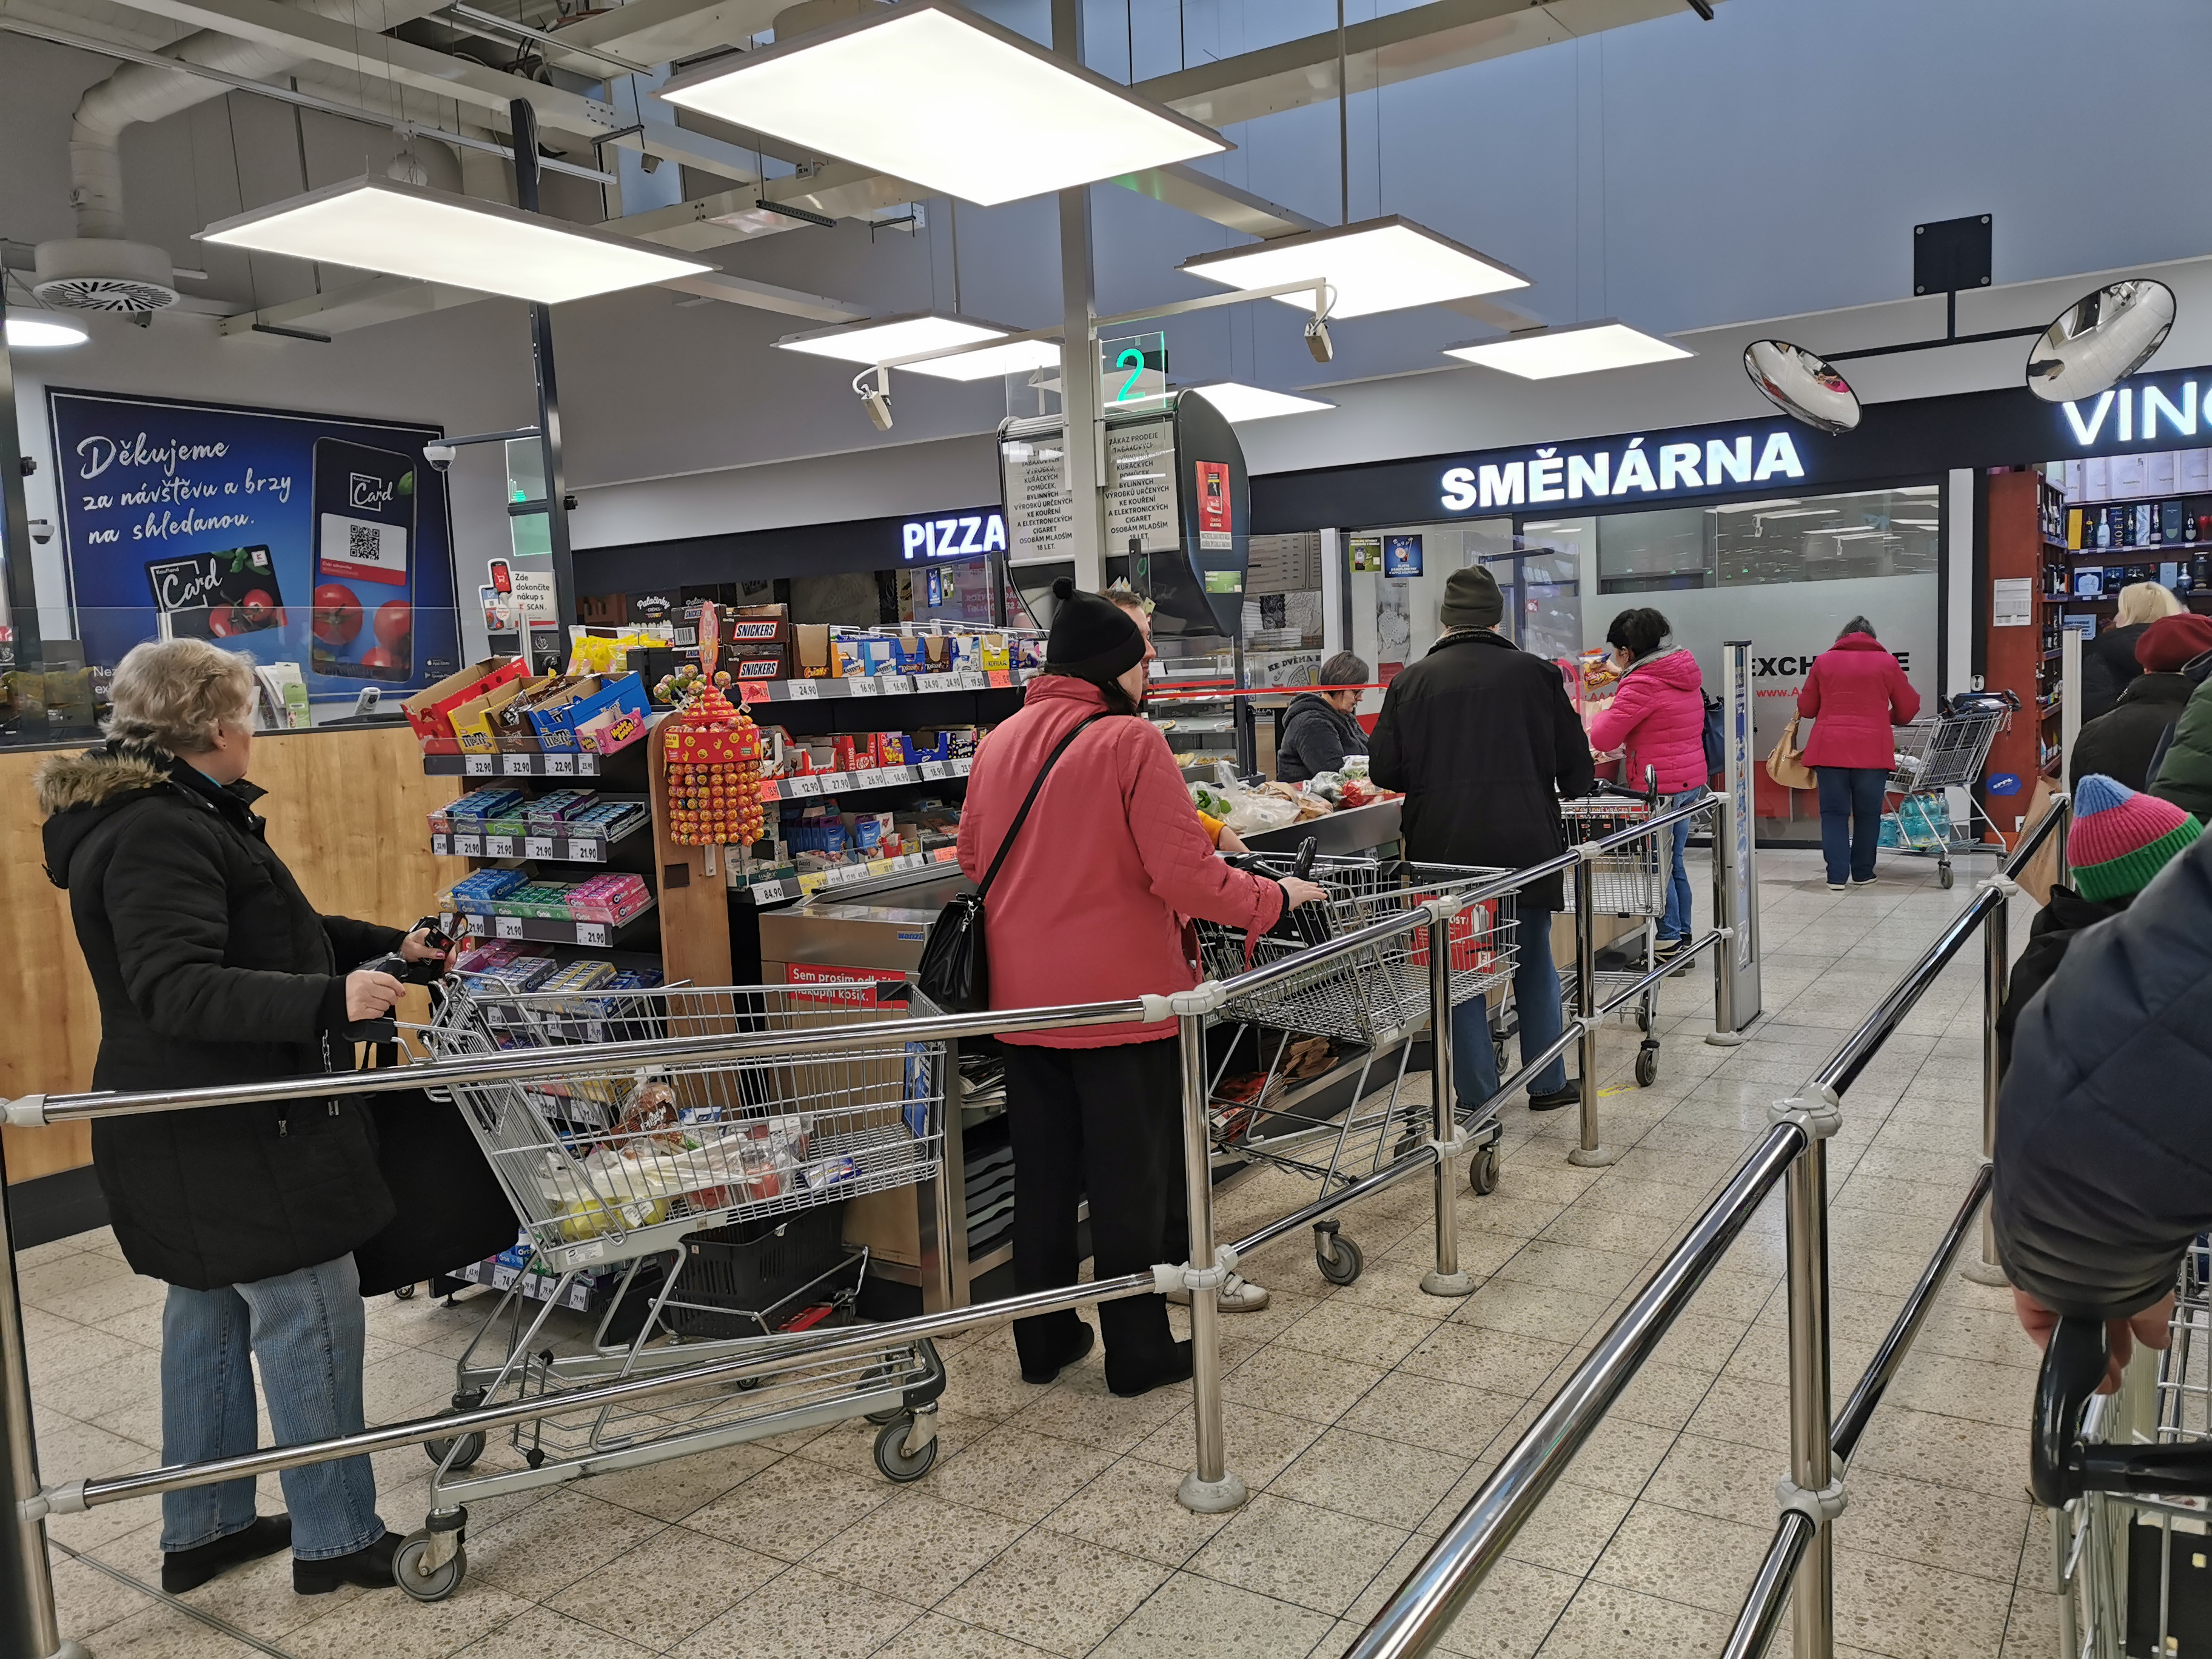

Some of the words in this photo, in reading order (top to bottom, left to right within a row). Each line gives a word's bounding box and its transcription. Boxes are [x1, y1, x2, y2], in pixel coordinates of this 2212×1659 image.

[1116, 349, 1145, 401] 2
[2063, 382, 2212, 445] VIN
[1109, 436, 1130, 446] ZÁKAZ
[1131, 432, 1158, 441] PRODEJE
[77, 432, 229, 479] Děkujeme
[1441, 432, 1805, 511] SMĚNÁRNA
[1024, 474, 1058, 483] KUŘÁCKÝCH
[83, 495, 113, 511] za
[121, 479, 218, 505] návštěvu
[224, 482, 239, 494] a
[245, 468, 291, 503] brzy
[354, 481, 394, 505] Card
[1105, 489, 1134, 499] VÝROBKŮ
[1136, 485, 1169, 495] URČENÝCH
[1027, 491, 1059, 500] BYLINNÝCH
[1128, 495, 1156, 505] KOUŘENÍ
[1014, 501, 1041, 511] VÝROBKŮ
[1042, 497, 1073, 507] URČENÝCH
[1114, 503, 1168, 515] ELEKTRONICKÝCH
[1036, 507, 1061, 516] KOUŘENÍ
[1023, 515, 1072, 526] ELEKTRONICKÝCH
[1125, 515, 1151, 523] CIGARET
[89, 529, 119, 545] na
[132, 508, 255, 540] shledanou.
[1033, 526, 1057, 534] CIGARET
[1111, 525, 1138, 534] OSOBÁM
[1139, 521, 1168, 531] MLADŠÍM
[903, 515, 1006, 559] PIZZA
[1020, 535, 1044, 544] OSOBÁM
[1045, 532, 1072, 542] MLADŠÍM
[156, 566, 179, 575] Kaufland
[163, 558, 223, 609] Card
[517, 593, 538, 602] nákup
[637, 596, 671, 611] Palačinky
[736, 624, 775, 637] SNICKERS
[741, 663, 777, 675] SNICKERS
[924, 679, 939, 689] 24.90
[946, 677, 960, 688] 24.90
[971, 676, 984, 686] 19.50
[799, 686, 816, 695] 24.90
[860, 683, 876, 693] 16.90
[893, 682, 908, 692] 16.90
[475, 762, 491, 773] 32.90
[513, 762, 529, 773] 32.90
[555, 762, 572, 772] 22.90
[930, 768, 944, 777] 18.90
[867, 775, 883, 785] 26.90
[894, 773, 909, 782] 14.90
[802, 782, 818, 793] 12.90
[832, 779, 848, 789] 27.90
[464, 843, 480, 854] 21.90
[497, 845, 512, 855] 21.90
[536, 846, 552, 857] 21.90
[580, 848, 596, 859] 21.90
[497, 883, 512, 895] Orbit
[763, 888, 782, 899] 84.90
[614, 890, 628, 903] Orbit
[575, 912, 591, 920] Orbit
[469, 923, 483, 934] 21.90
[507, 925, 521, 936] 21.90
[588, 932, 604, 943] 21.90
[793, 968, 815, 980] Sem
[819, 973, 854, 983] prosím
